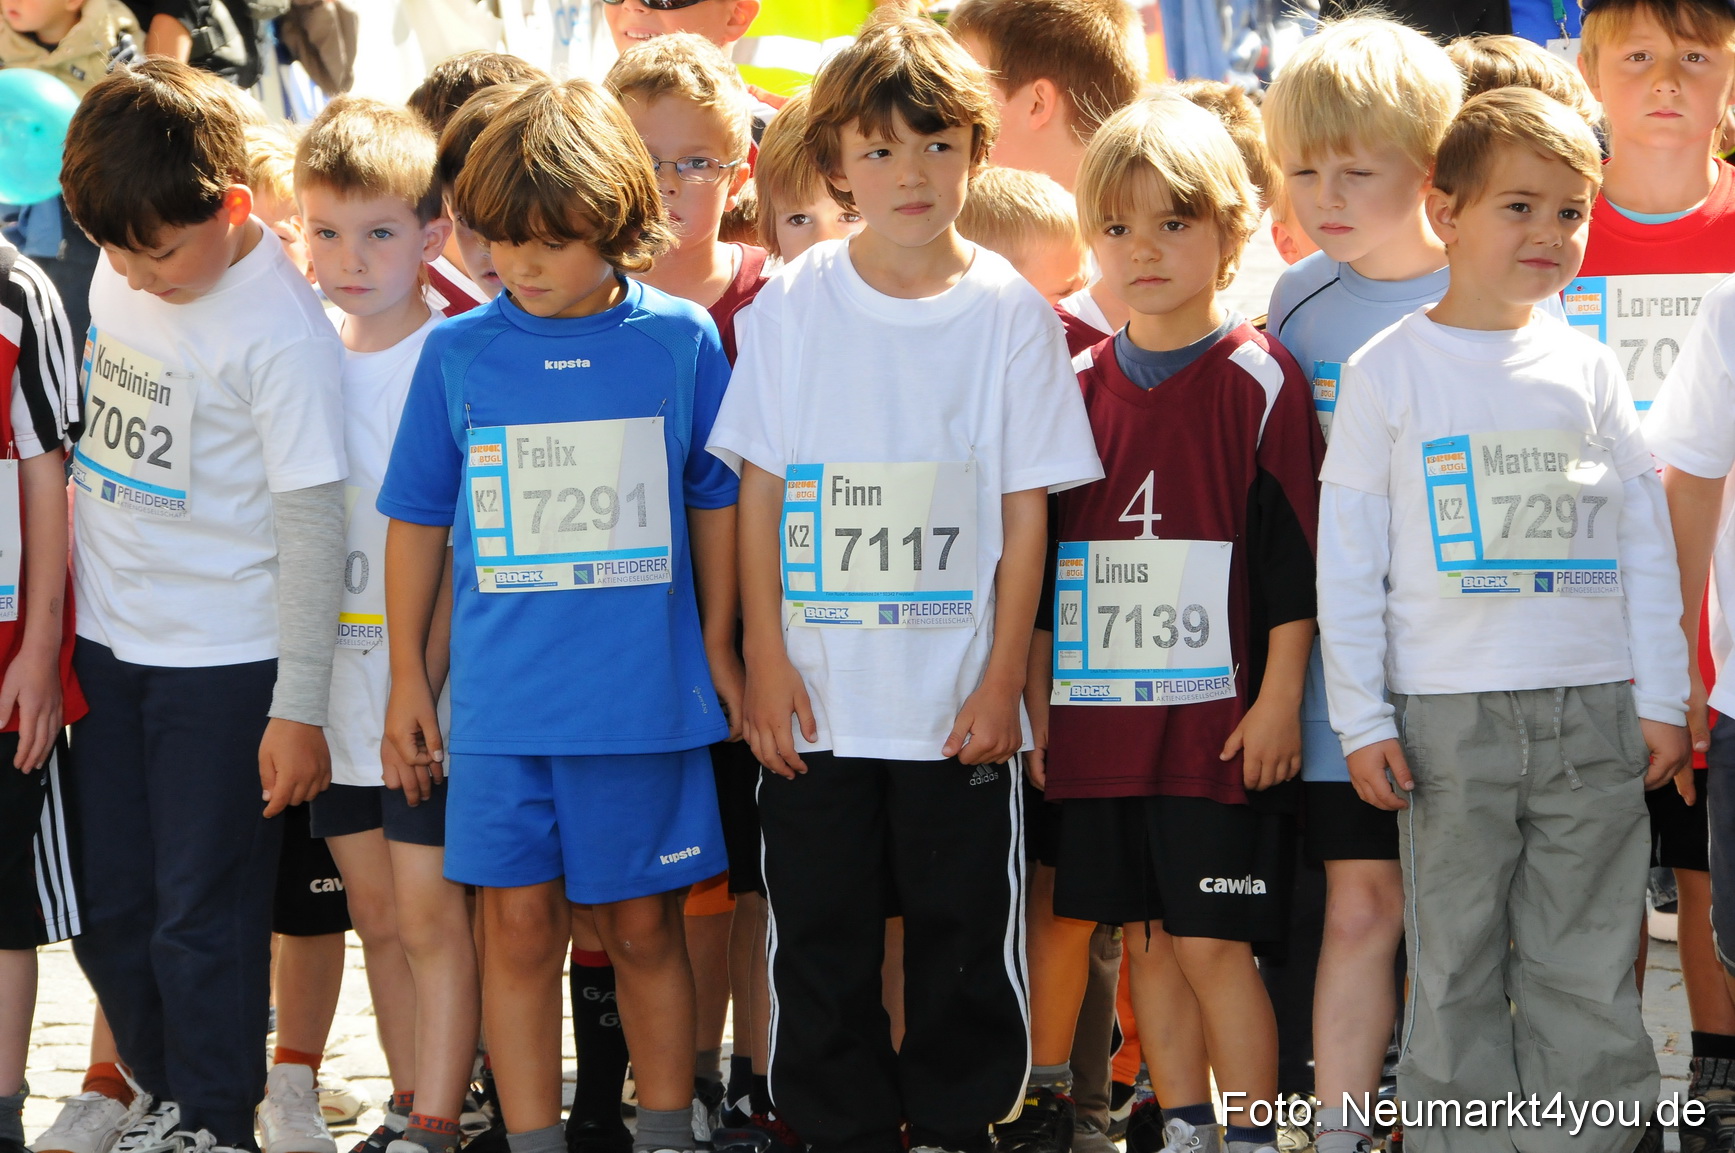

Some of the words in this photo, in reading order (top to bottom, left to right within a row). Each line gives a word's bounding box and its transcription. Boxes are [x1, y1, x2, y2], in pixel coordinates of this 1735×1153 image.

[1617, 288, 1702, 318] Lorenz
[95, 343, 171, 406] Korbinian
[545, 358, 591, 370] kipsta
[88, 395, 173, 470] 7062
[516, 436, 577, 469] Felix
[1440, 462, 1466, 472] BÜGL
[117, 485, 186, 511] PFLEIDERER
[475, 489, 498, 513] K2
[832, 475, 882, 506] Finn
[523, 483, 648, 534] 7291
[1118, 469, 1162, 540] 4
[1438, 497, 1464, 521] K2
[1491, 493, 1608, 539] 7297
[788, 524, 810, 548] K2
[835, 527, 960, 571] 7117
[495, 570, 544, 584] BOCK
[596, 558, 668, 576] PFLEIDERER
[1095, 553, 1149, 583] Linus
[1557, 571, 1618, 585] PFLEIDERER
[597, 573, 670, 585] AKTIENGESELLSCHAFT
[1461, 576, 1508, 588] BOCK
[804, 607, 849, 619] BOCK
[902, 602, 972, 616] PFLEIDERER
[1061, 603, 1078, 626] K2
[902, 617, 974, 625] AKTIENGESELLSCHAFT
[1098, 604, 1210, 649] 7139
[1069, 685, 1110, 697] BOCK
[1156, 676, 1230, 694] PFLEIDERER
[1156, 689, 1232, 702] AKTIENGESELLSCHAFT
[969, 771, 999, 786] adidas
[660, 845, 701, 865] kipsta
[1199, 873, 1267, 895] cawila
